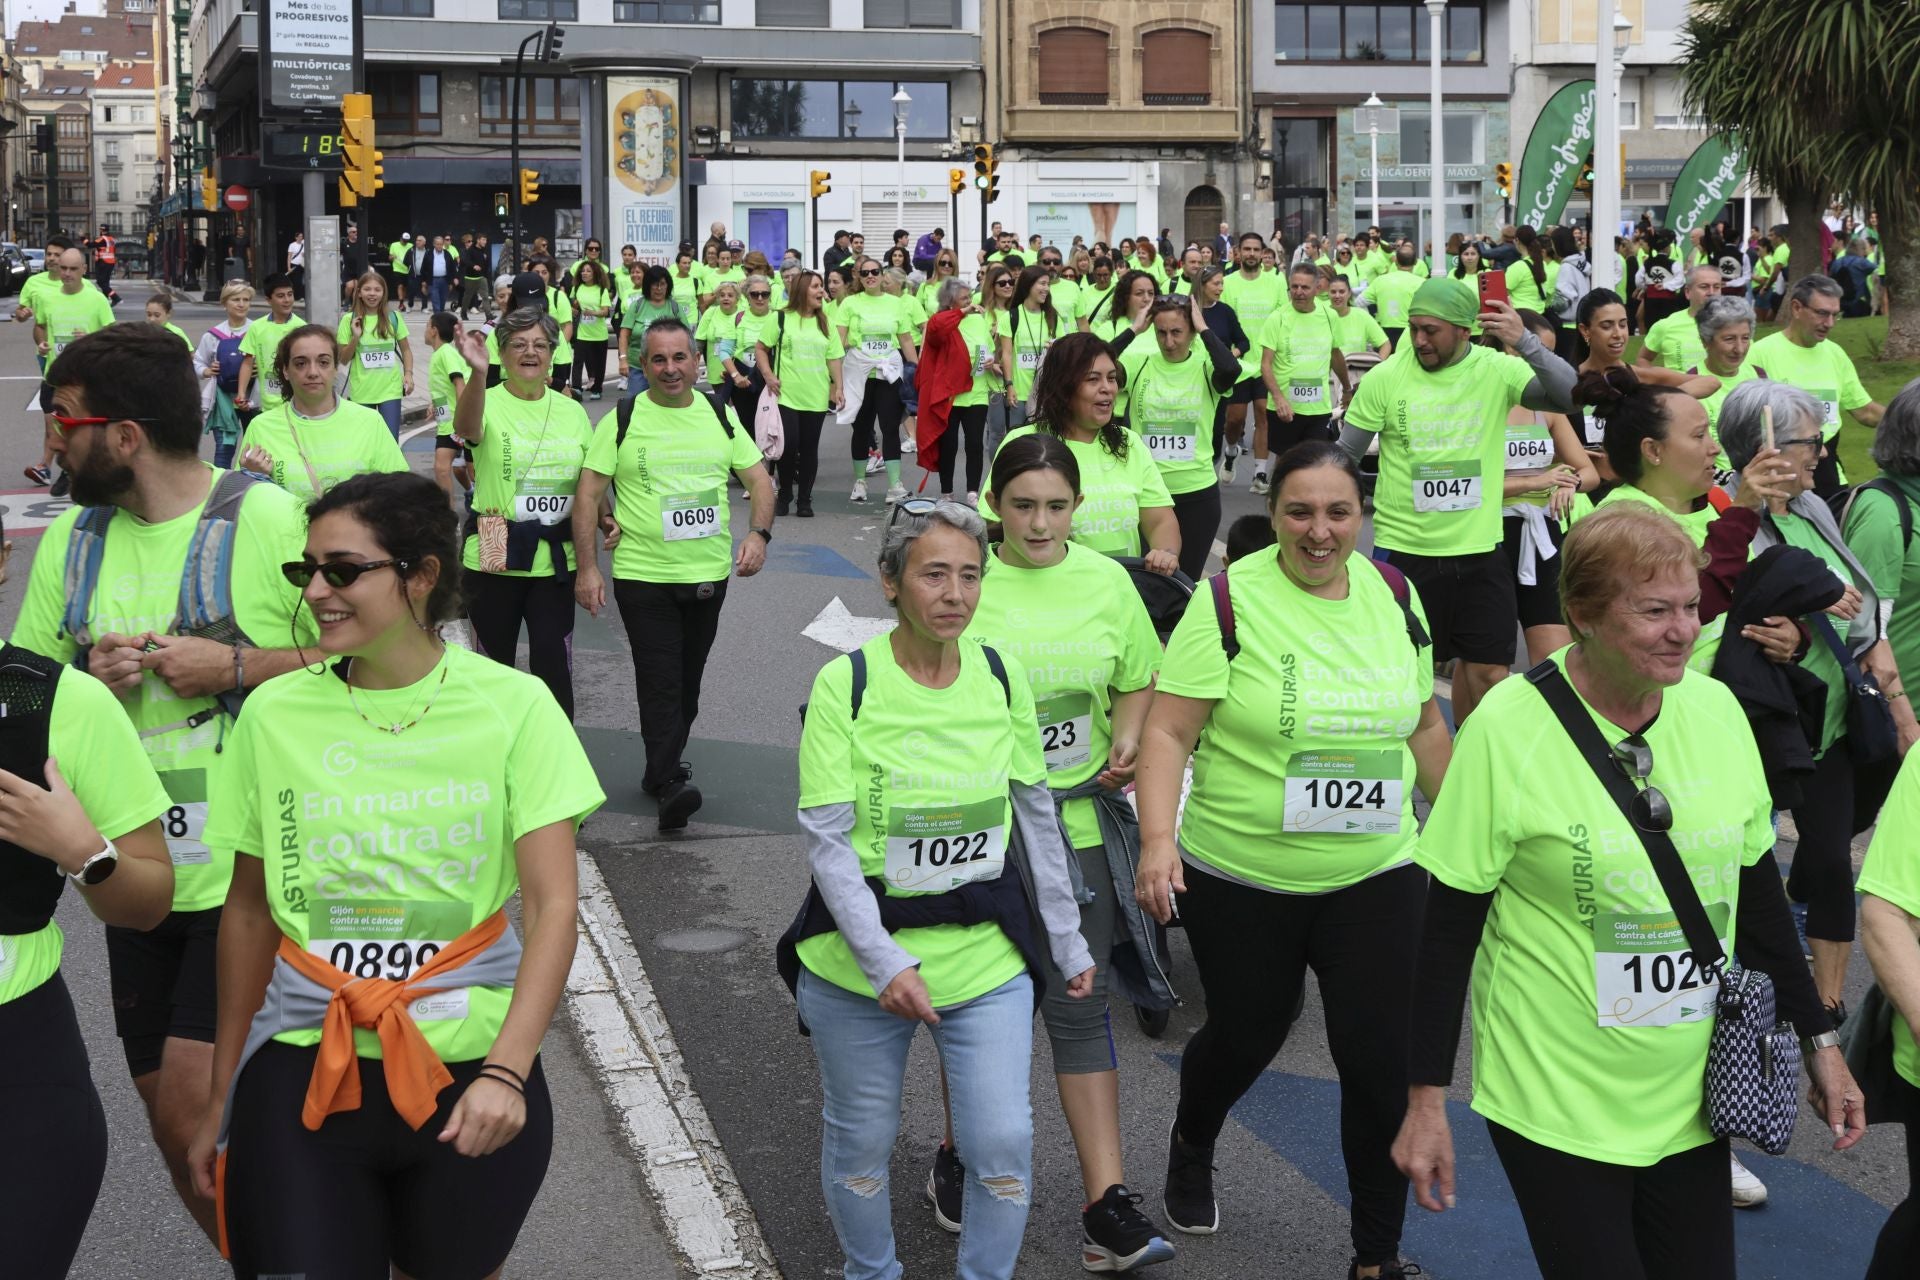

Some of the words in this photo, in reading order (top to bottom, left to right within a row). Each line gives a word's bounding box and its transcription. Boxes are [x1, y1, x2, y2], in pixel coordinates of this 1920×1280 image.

[288, 1, 308, 9] Mes
[311, 2, 322, 10] de
[324, 2, 336, 11] los
[276, 12, 348, 23] PROGRESIVOS
[1360, 168, 1402, 177] CLNICA
[1404, 168, 1433, 177] DENT
[1447, 168, 1478, 177] MAYO
[1536, 161, 1567, 211] Corte
[626, 209, 637, 223] EL
[640, 209, 673, 224] REFUGIO
[866, 341, 888, 350] 1259
[365, 351, 390, 363] 0575
[1293, 387, 1318, 397] 0051
[1397, 399, 1410, 454] ASTURIAS
[1149, 435, 1187, 450] 0113
[1508, 440, 1547, 457] 0664
[501, 431, 512, 482] ASTURIAS
[637, 447, 653, 496] ASTURIAS
[1423, 478, 1472, 498] 0047
[526, 496, 569, 513] 0607
[672, 507, 715, 528] 0609
[1029, 661, 1084, 685] ntra
[1279, 653, 1298, 740] ASTURIAS
[1303, 688, 1400, 709] contra
[303, 791, 343, 821] En
[353, 778, 491, 816] marcha
[1305, 779, 1386, 810] 1024
[868, 762, 886, 855] ASTURIAS
[905, 814, 925, 822] Gijón
[904, 820, 929, 828] contra
[938, 819, 962, 827] cáncer
[306, 821, 441, 863] contra
[448, 811, 487, 847] el
[1600, 829, 1640, 855] En
[279, 787, 309, 915] ASTURIAS
[908, 831, 988, 867] 1022
[315, 853, 488, 900] cáncer
[1568, 823, 1597, 932] ASTURIAS
[1604, 863, 1717, 894] cora
[330, 905, 354, 917] Gijón
[355, 906, 367, 914] en
[368, 905, 405, 916] marcha
[330, 916, 359, 925] contra
[360, 915, 370, 925] el
[371, 915, 405, 925] cáncer
[1614, 921, 1639, 931] Gijón
[1614, 931, 1646, 939] contra
[1647, 931, 1657, 939] el
